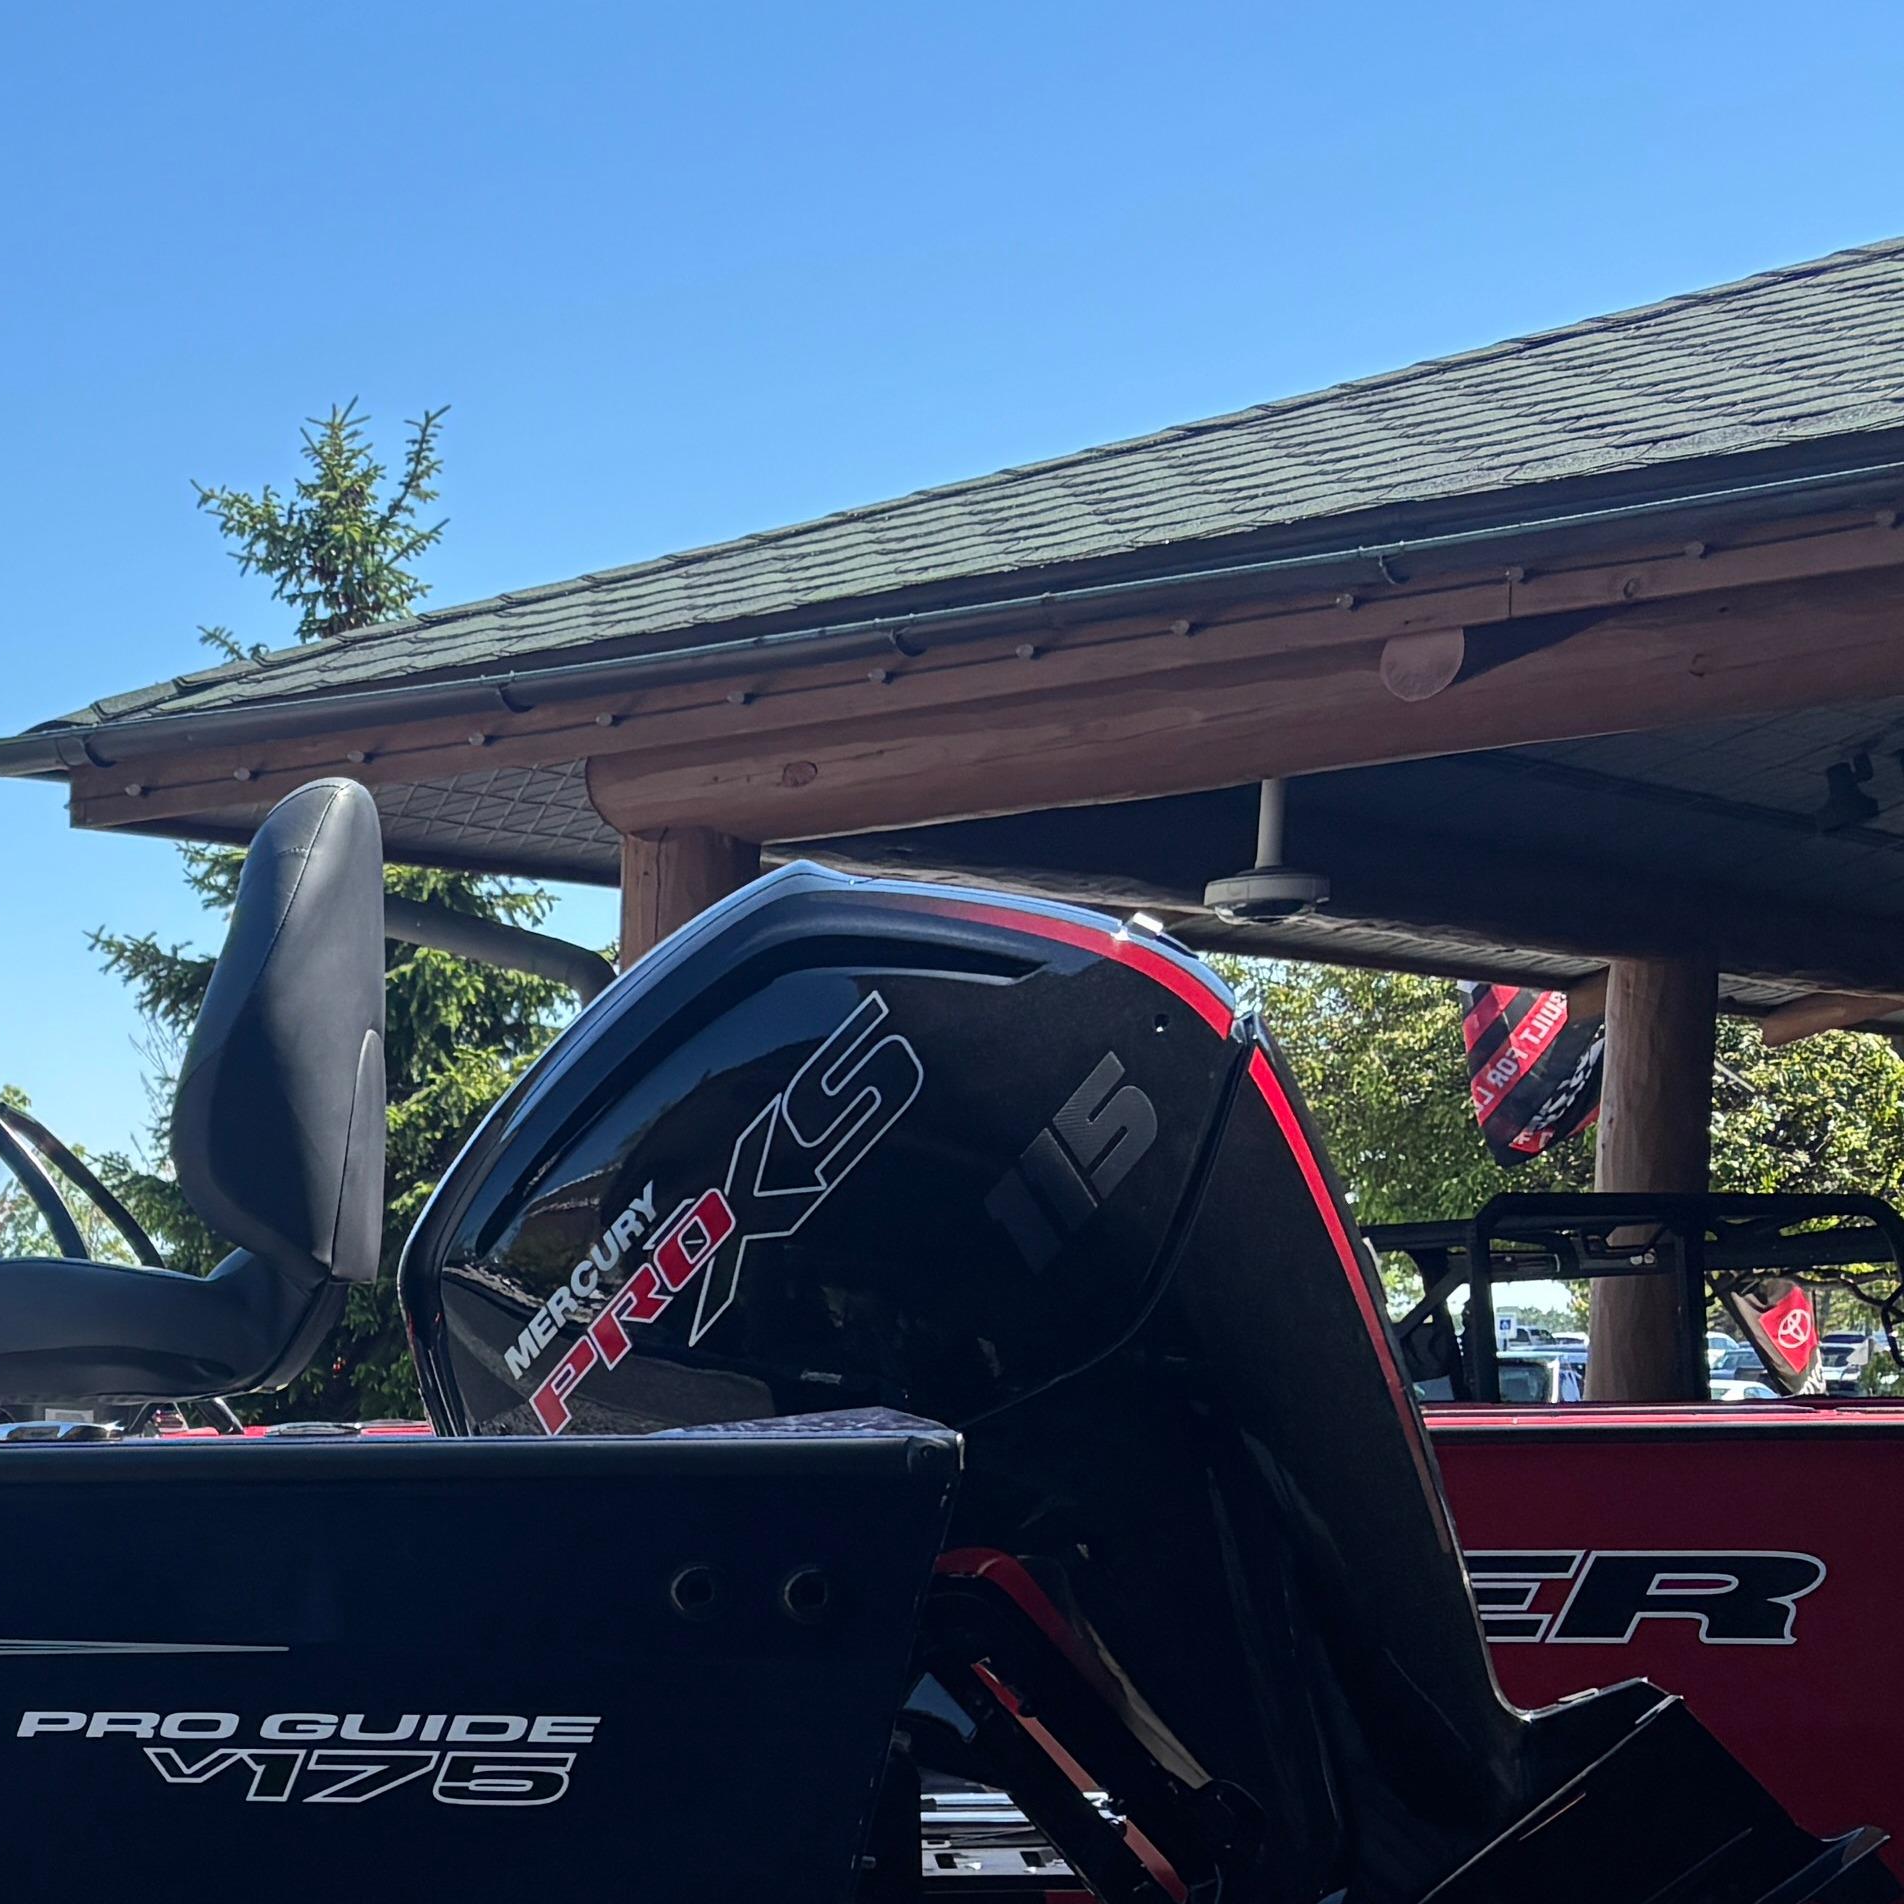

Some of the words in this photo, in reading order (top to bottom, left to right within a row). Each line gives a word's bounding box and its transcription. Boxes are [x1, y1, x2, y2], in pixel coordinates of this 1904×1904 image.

[983, 1050, 1159, 1275] 115
[503, 1179, 659, 1381] MERCURY
[528, 1186, 737, 1436] PRO
[17, 1710, 240, 1740] PRO
[258, 1711, 602, 1743] GUIDE
[143, 1748, 577, 1807] V175
